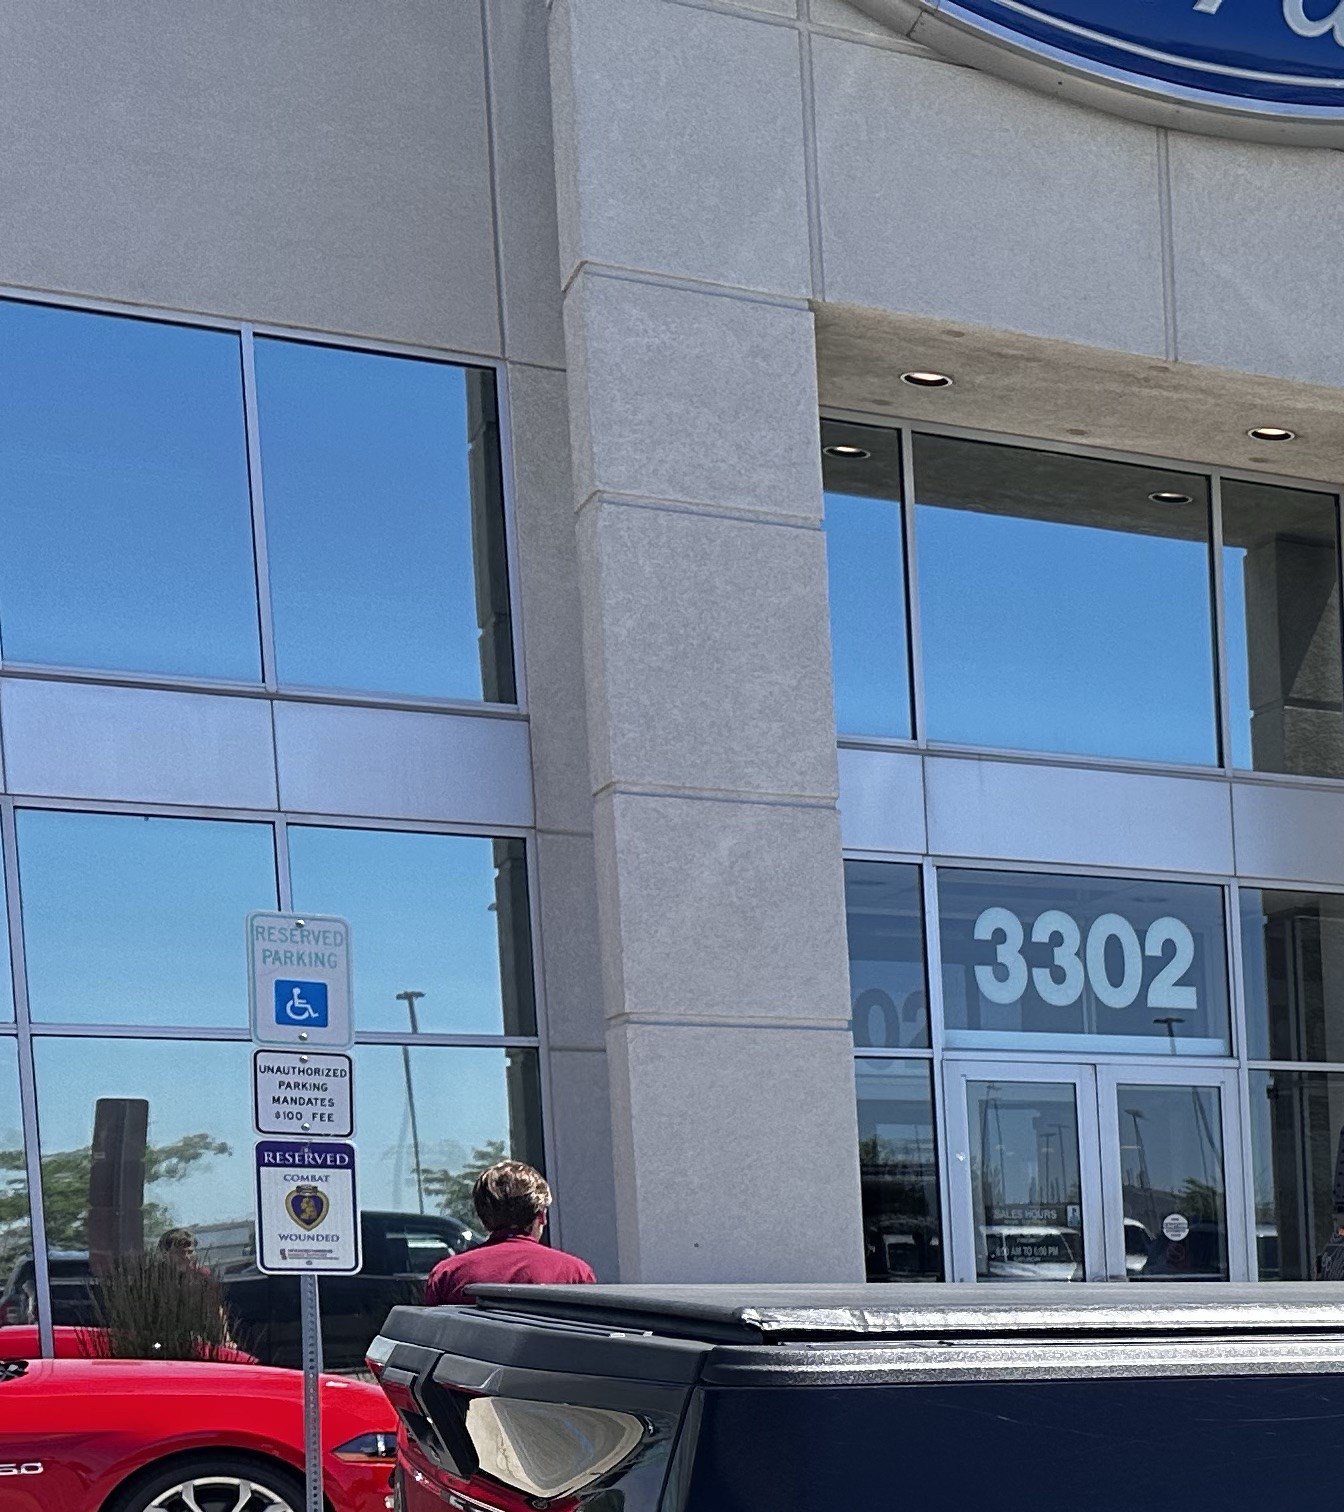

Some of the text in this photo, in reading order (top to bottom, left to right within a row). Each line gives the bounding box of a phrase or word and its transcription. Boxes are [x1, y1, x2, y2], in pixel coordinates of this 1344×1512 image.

[255, 925, 344, 947] RESERVED
[262, 948, 338, 969] PARKING
[974, 907, 1197, 1009] 3302
[259, 1065, 347, 1079] UNAUTHORIZED
[278, 1081, 328, 1092] PARKING
[272, 1096, 335, 1107] MANDATES
[274, 1111, 334, 1123] $100 FEE
[263, 1151, 349, 1166] RESERVED
[283, 1174, 330, 1183] COMBAT
[278, 1233, 340, 1243] WOUNDED
